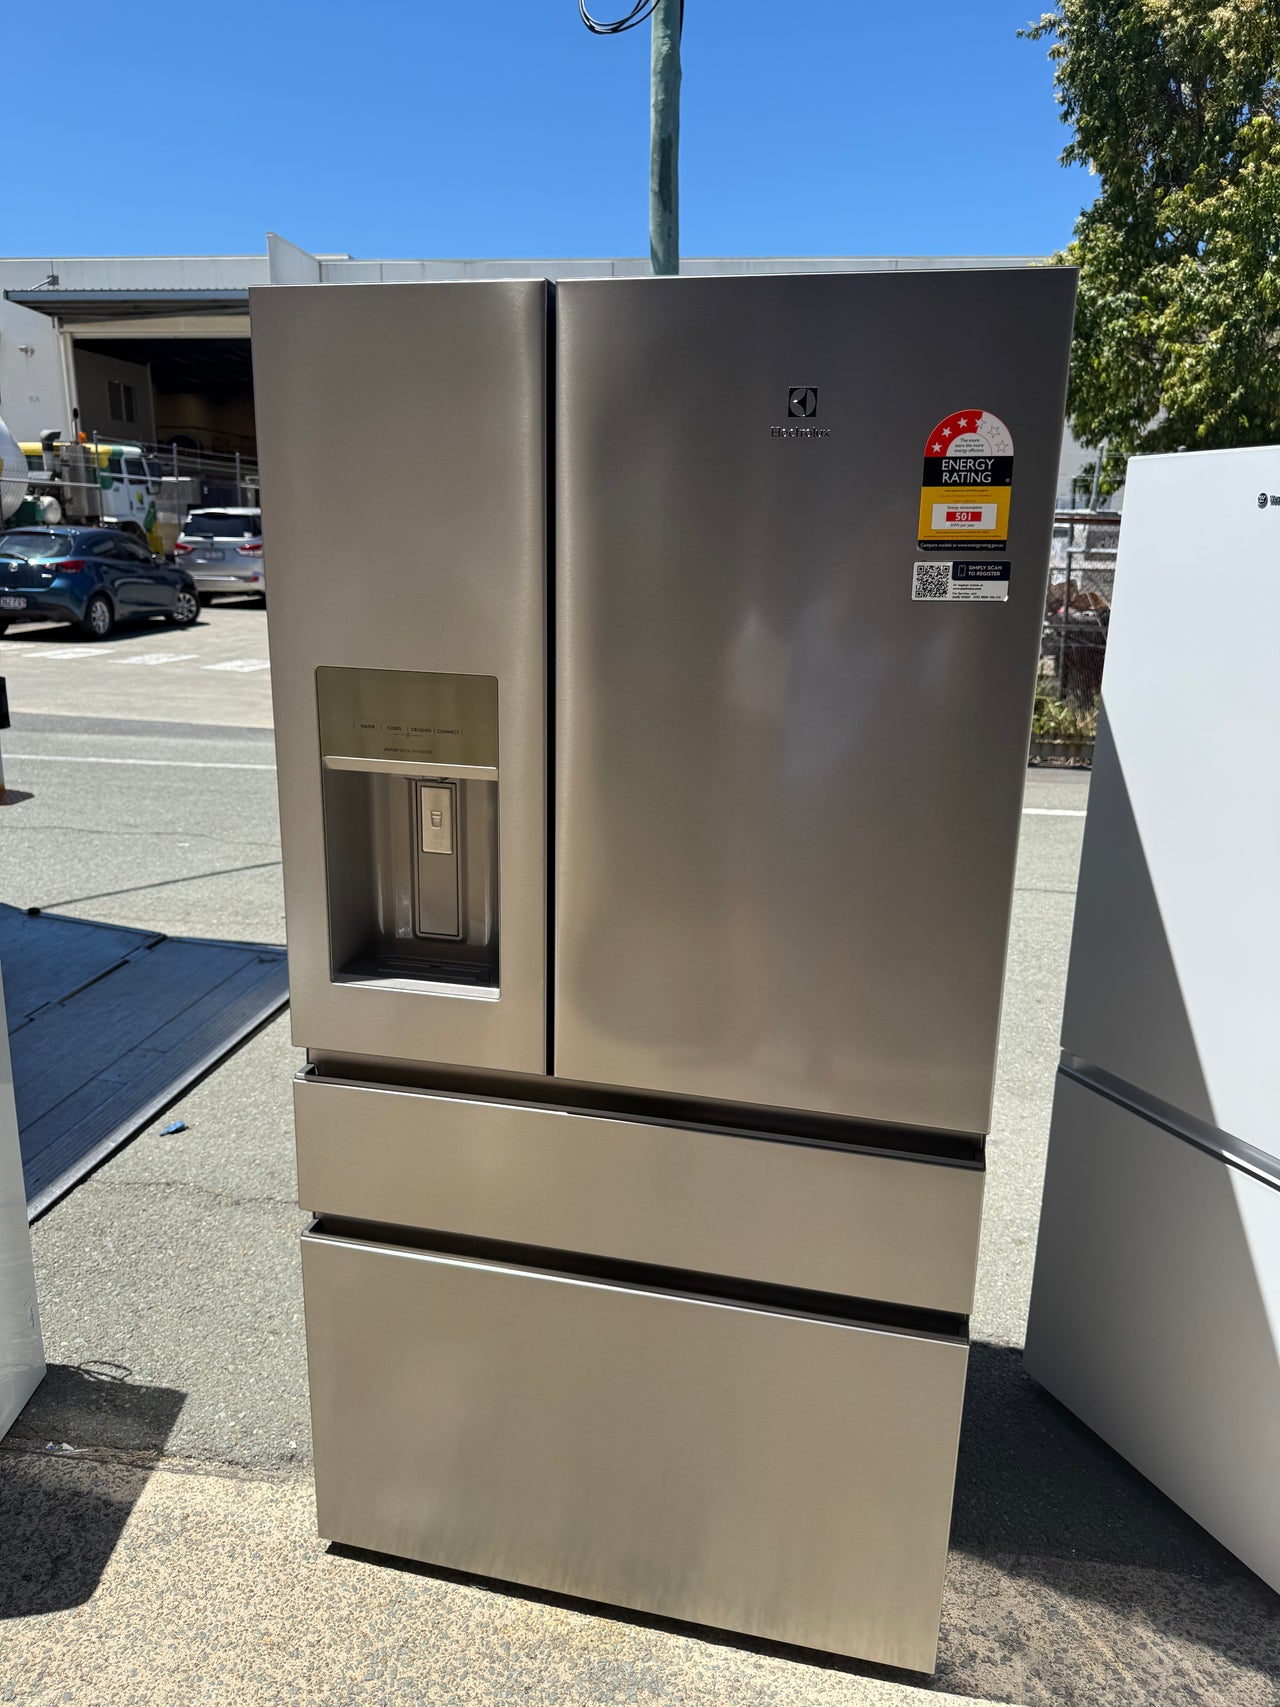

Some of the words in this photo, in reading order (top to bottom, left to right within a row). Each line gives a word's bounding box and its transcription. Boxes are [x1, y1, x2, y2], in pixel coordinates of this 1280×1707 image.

[770, 426, 831, 438] Electrolux
[942, 458, 994, 470] ENERGY
[942, 472, 992, 484] RATING
[955, 512, 971, 521] 501
